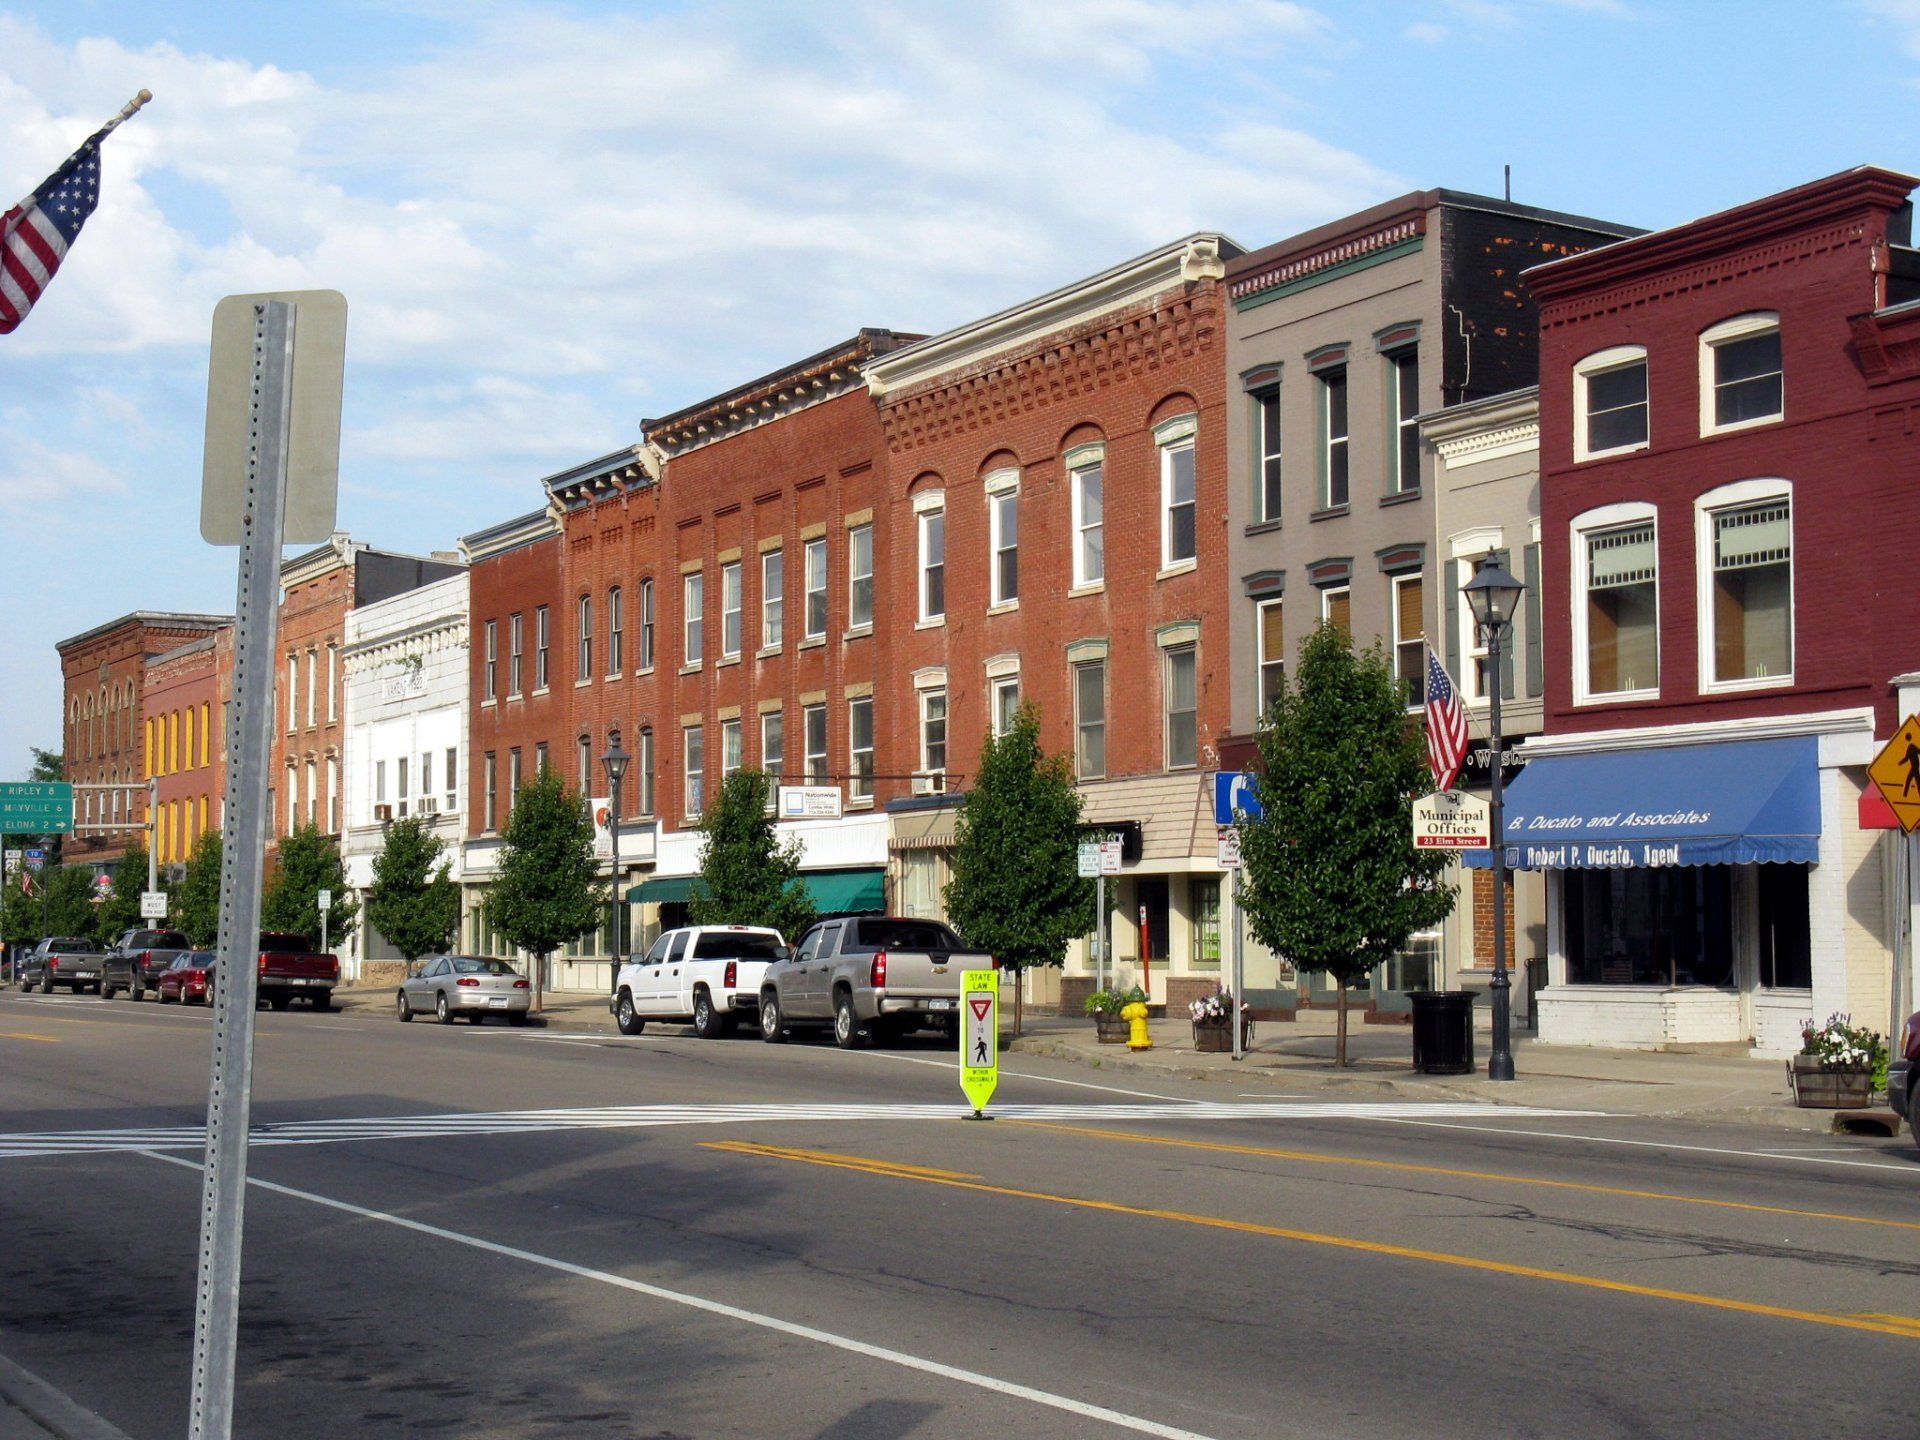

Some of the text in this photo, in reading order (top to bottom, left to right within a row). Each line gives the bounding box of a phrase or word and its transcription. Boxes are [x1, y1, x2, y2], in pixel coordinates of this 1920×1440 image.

[8, 787, 41, 795] RIPLEY
[4, 803, 63, 812] MAYVILLE 6
[1419, 809, 1484, 824] Municipal
[1508, 810, 1711, 829] B. Ducato and Associates
[0, 820, 49, 829] ELONA 2
[1427, 823, 1477, 834] Offices
[1527, 847, 1566, 866] Robert
[1571, 846, 1581, 865] P.
[1587, 845, 1634, 867] Ducato,
[1644, 844, 1679, 867] Agent
[970, 973, 992, 981] STATE
[973, 982, 988, 990] LAW
